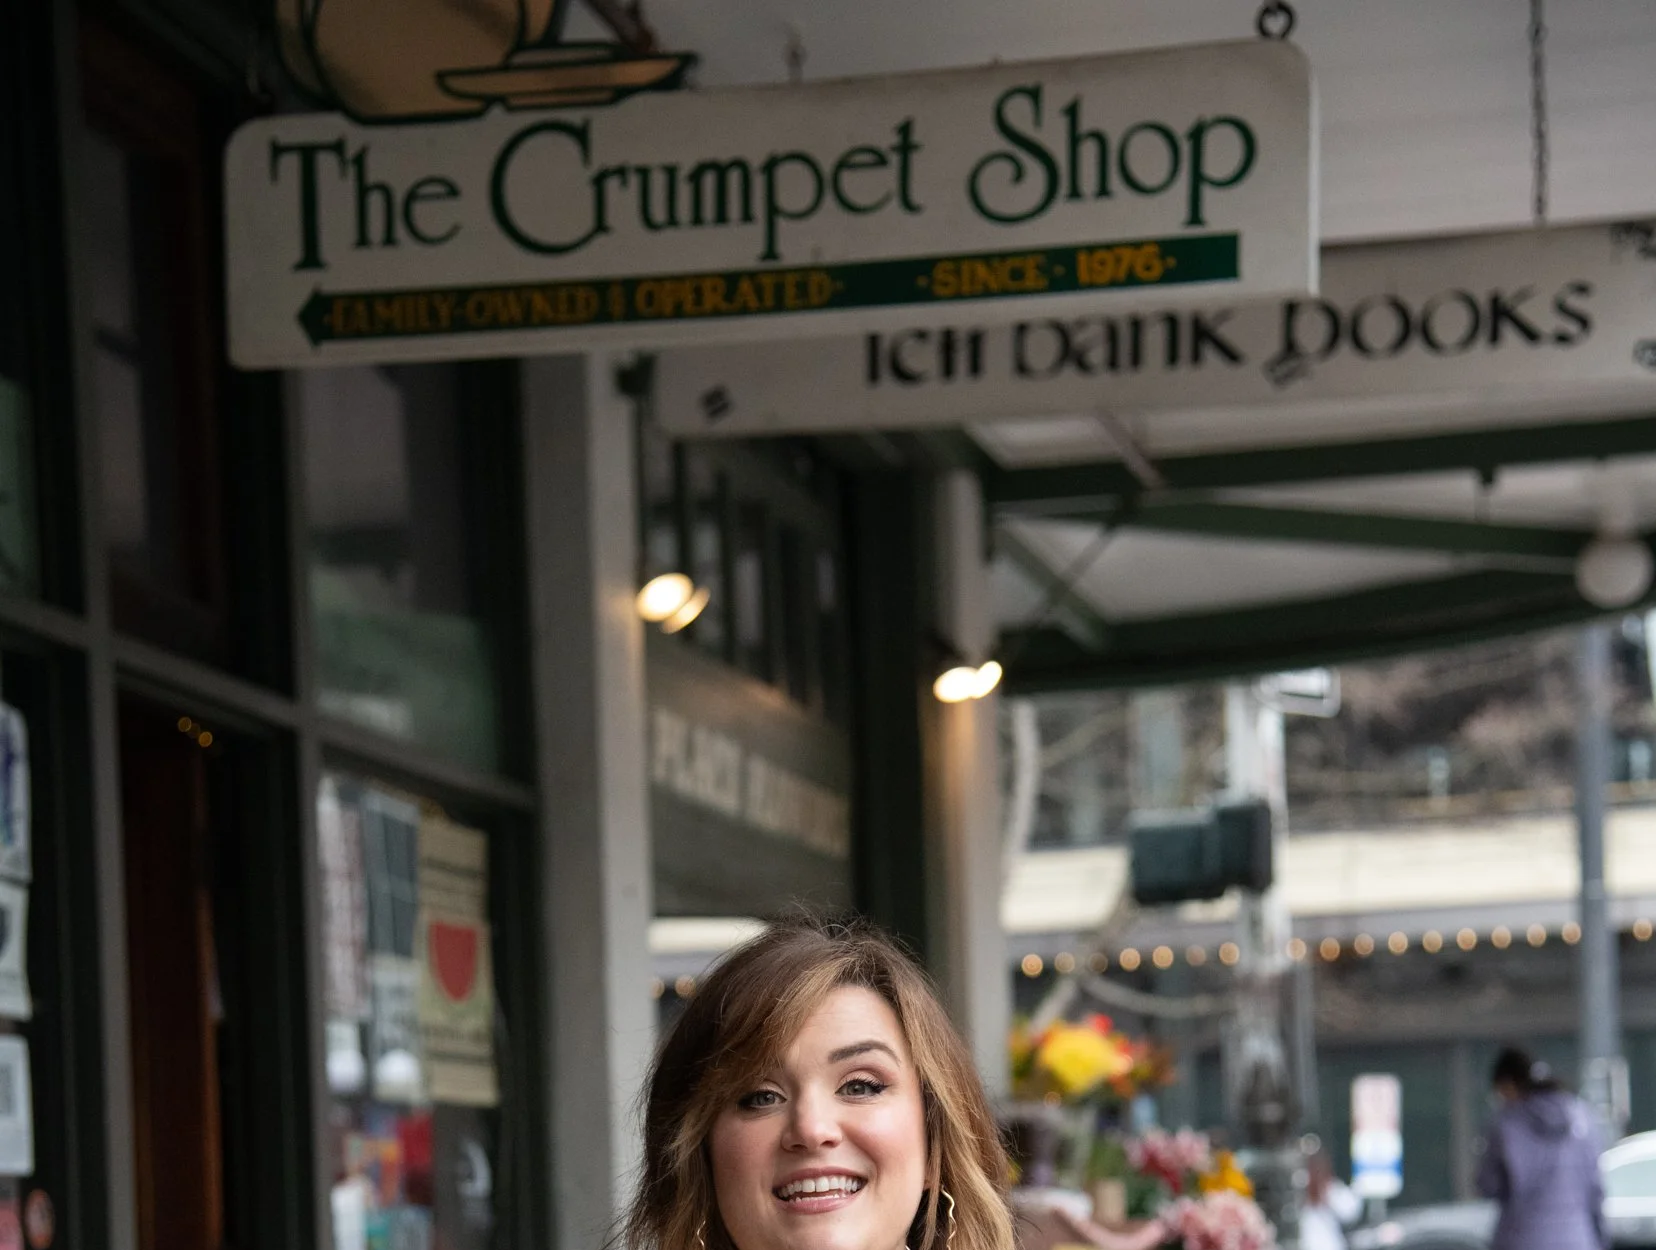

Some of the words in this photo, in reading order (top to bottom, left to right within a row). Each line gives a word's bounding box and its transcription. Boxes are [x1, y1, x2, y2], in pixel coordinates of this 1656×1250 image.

[269, 136, 461, 272] The
[489, 116, 923, 261] Crumpet
[968, 82, 1257, 227] Shop
[931, 254, 1048, 299] SINCE
[1077, 243, 1164, 286] 1976
